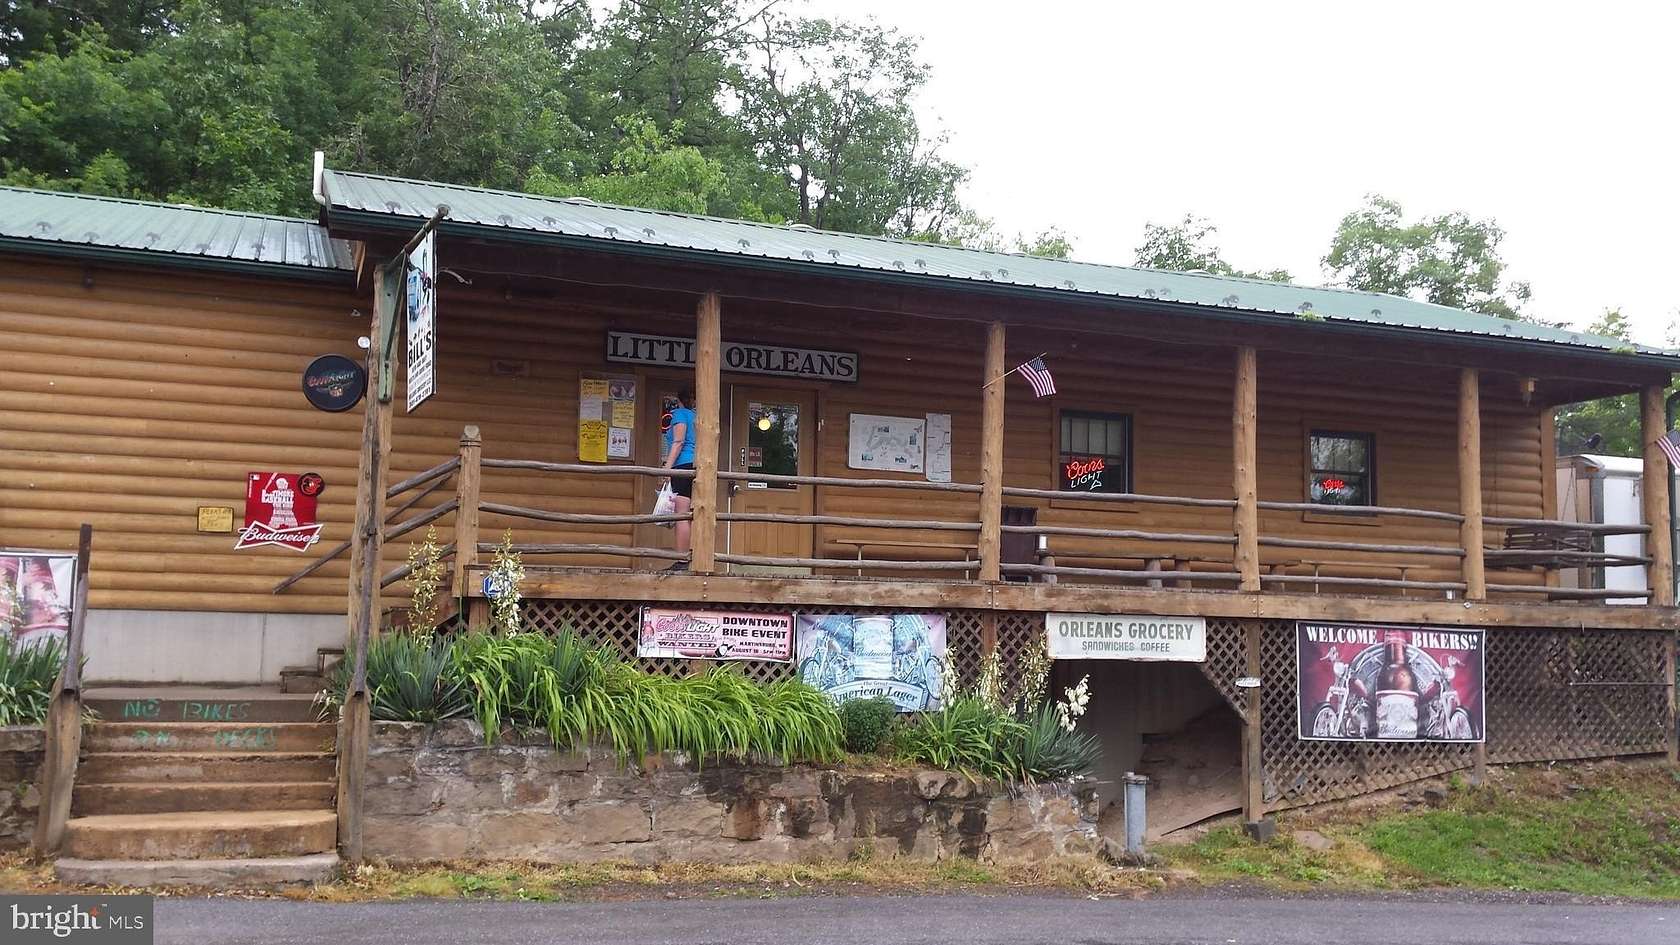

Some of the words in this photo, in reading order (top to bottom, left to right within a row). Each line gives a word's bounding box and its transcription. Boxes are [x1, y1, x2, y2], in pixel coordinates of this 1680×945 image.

[409, 330, 432, 368] BILL'S
[609, 336, 697, 364] LITTL
[726, 346, 854, 377] ORLEANS
[1066, 459, 1104, 479] Coors
[1070, 471, 1102, 488] LIGHT
[238, 527, 320, 544] Budweiser
[685, 622, 720, 633] LIGHT
[722, 616, 788, 628] DOWNTOWN
[1058, 620, 1123, 639] ORLEANS
[1128, 622, 1194, 640] GROCERY
[722, 628, 749, 637] BIKE
[751, 629, 788, 639] EVENT
[1306, 626, 1378, 645] WELCOME
[1412, 631, 1478, 650] BIKERS!!
[657, 641, 717, 649] WANTED
[1081, 640, 1135, 652] SANDWICHES
[1140, 642, 1170, 653] COFFEE
[832, 686, 884, 703] American
[887, 686, 918, 703] Lager
[124, 699, 161, 719] NO
[181, 701, 251, 720] BIKES
